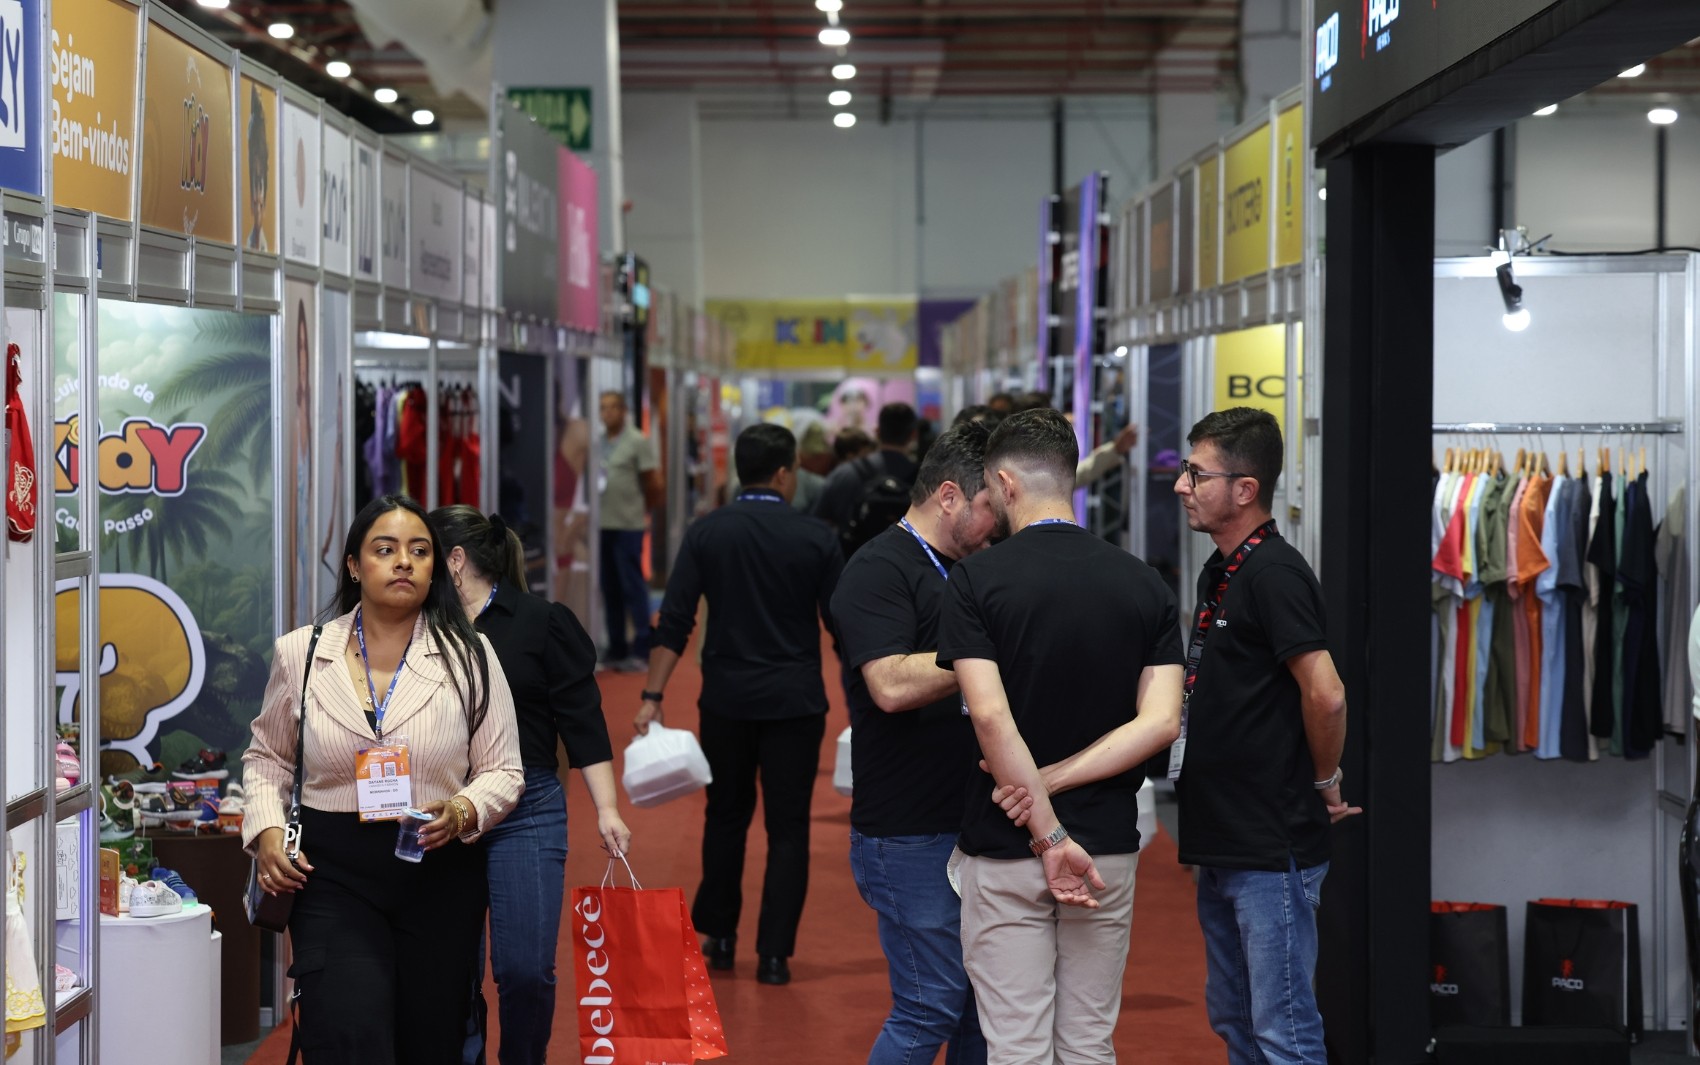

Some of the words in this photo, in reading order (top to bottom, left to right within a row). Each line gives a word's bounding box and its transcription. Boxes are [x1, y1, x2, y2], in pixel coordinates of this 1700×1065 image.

[1368, 0, 1399, 37] PA
[51, 29, 94, 103] Sejam
[52, 99, 129, 175] Bem-vindos
[55, 371, 130, 403] uindo
[133, 382, 154, 404] de
[1229, 375, 1303, 399] BO
[55, 507, 80, 532] Ca
[104, 508, 153, 535] Passo
[575, 895, 615, 1065] bebecê
[1552, 977, 1583, 990] PACO
